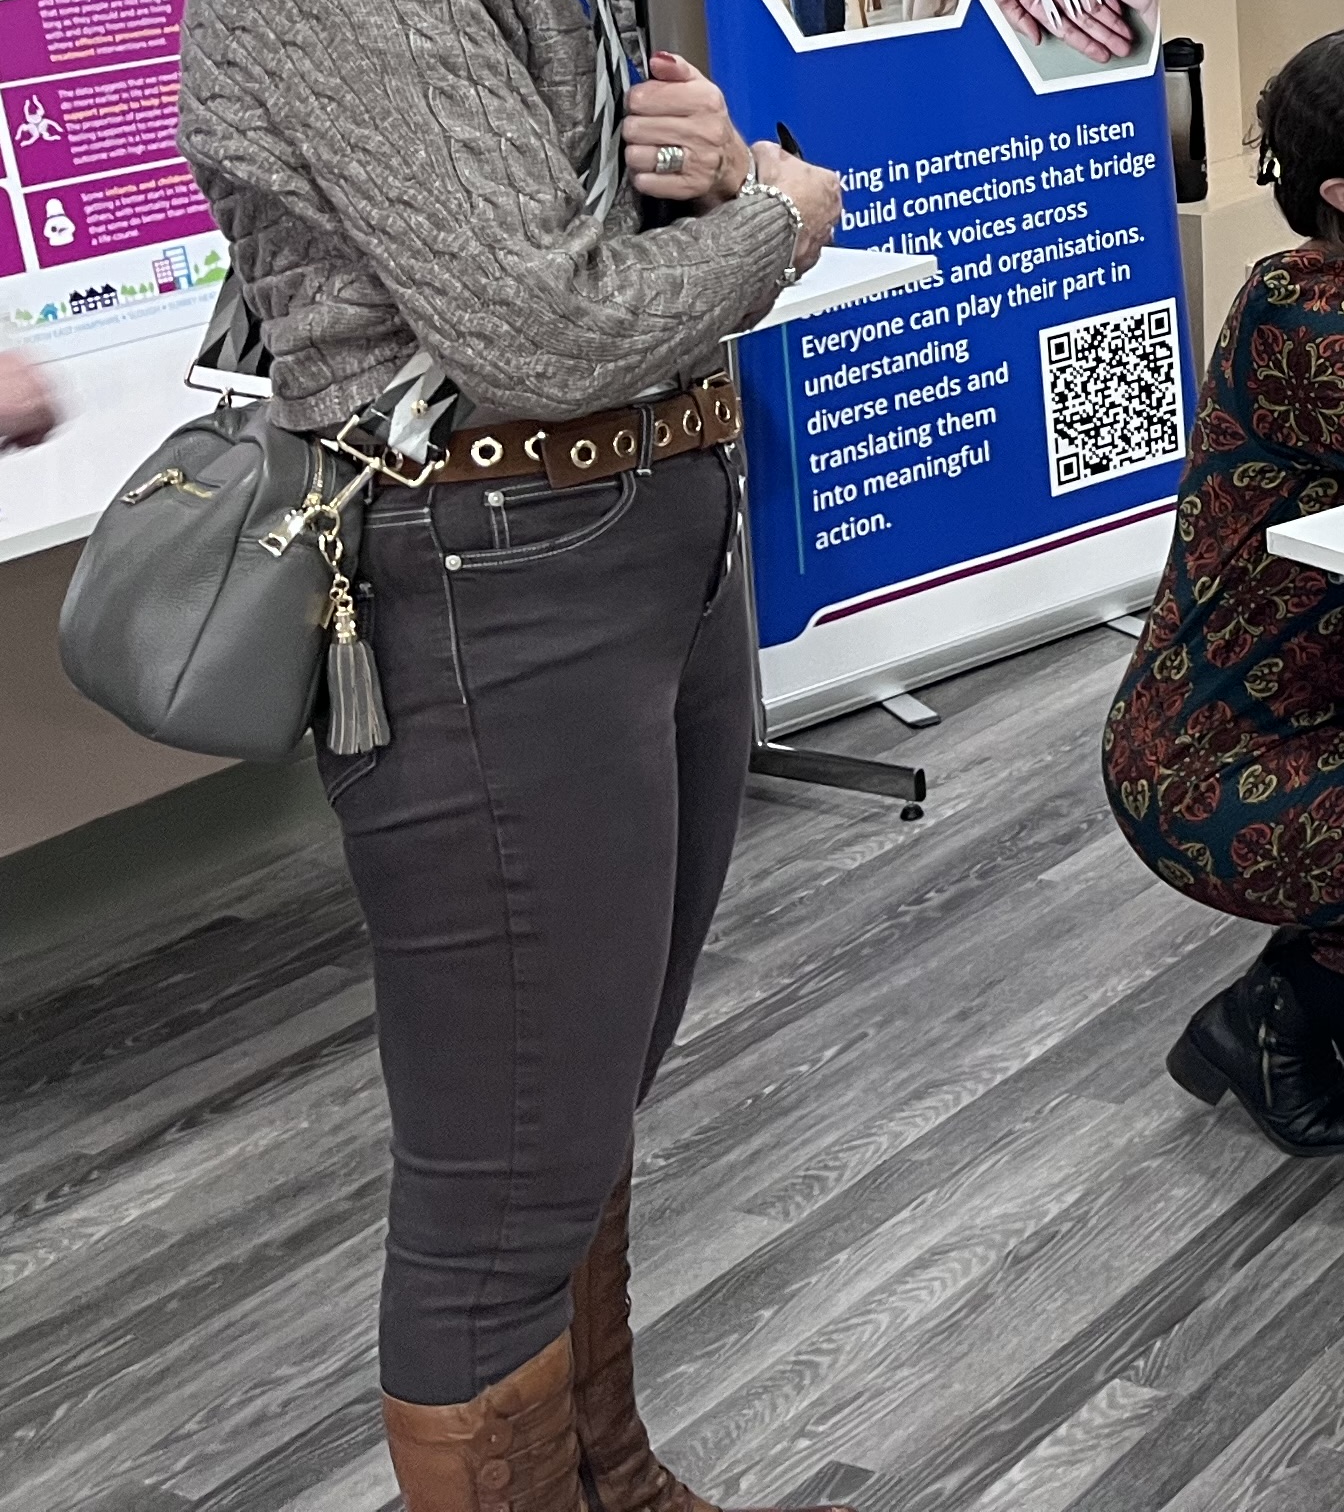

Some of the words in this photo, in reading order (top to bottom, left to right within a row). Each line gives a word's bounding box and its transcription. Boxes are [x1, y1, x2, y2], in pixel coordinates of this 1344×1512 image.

[836, 168, 884, 193] king
[888, 160, 909, 182] in
[915, 134, 1043, 186] partnership
[1048, 127, 1072, 151] to
[1075, 119, 1136, 144] listen
[841, 198, 897, 232] build
[902, 170, 1037, 219] connections
[1040, 161, 1086, 189] that
[1089, 150, 1157, 182] bridge
[901, 227, 943, 255] link
[947, 216, 1017, 250] voices
[1021, 199, 1088, 231] across
[950, 254, 993, 285] and
[997, 222, 1146, 272] organisations.
[802, 316, 904, 359] Everyone
[909, 306, 948, 331] can
[955, 293, 1002, 327] play
[1007, 277, 1057, 308] their
[1061, 268, 1106, 299] part
[1110, 262, 1131, 283] in
[804, 336, 969, 397] understanding
[806, 397, 888, 436] diverse
[893, 380, 962, 413] needs
[967, 362, 1009, 389] and
[809, 425, 932, 474] translating
[936, 405, 997, 438] them
[812, 482, 857, 512] into
[862, 440, 991, 496] meaningful
[814, 511, 892, 550] action.
